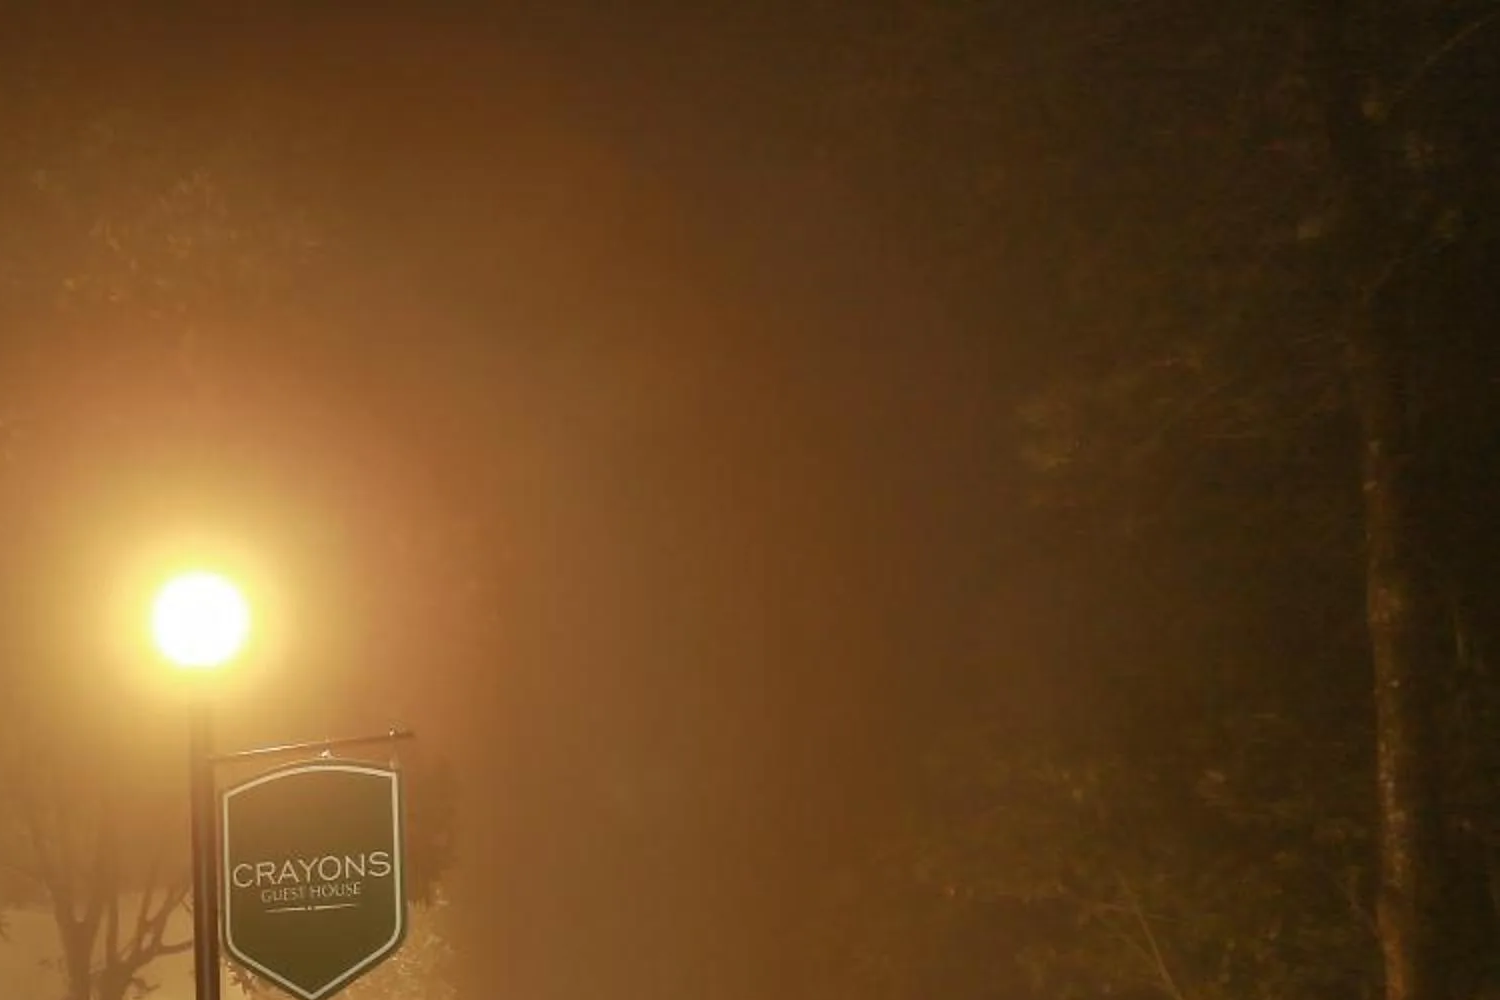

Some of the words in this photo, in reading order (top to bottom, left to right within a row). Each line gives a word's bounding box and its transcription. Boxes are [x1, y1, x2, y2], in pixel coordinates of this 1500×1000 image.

[233, 851, 391, 887] CRAYONS
[261, 886, 304, 903] GUEST
[309, 881, 361, 898] HOUSE
